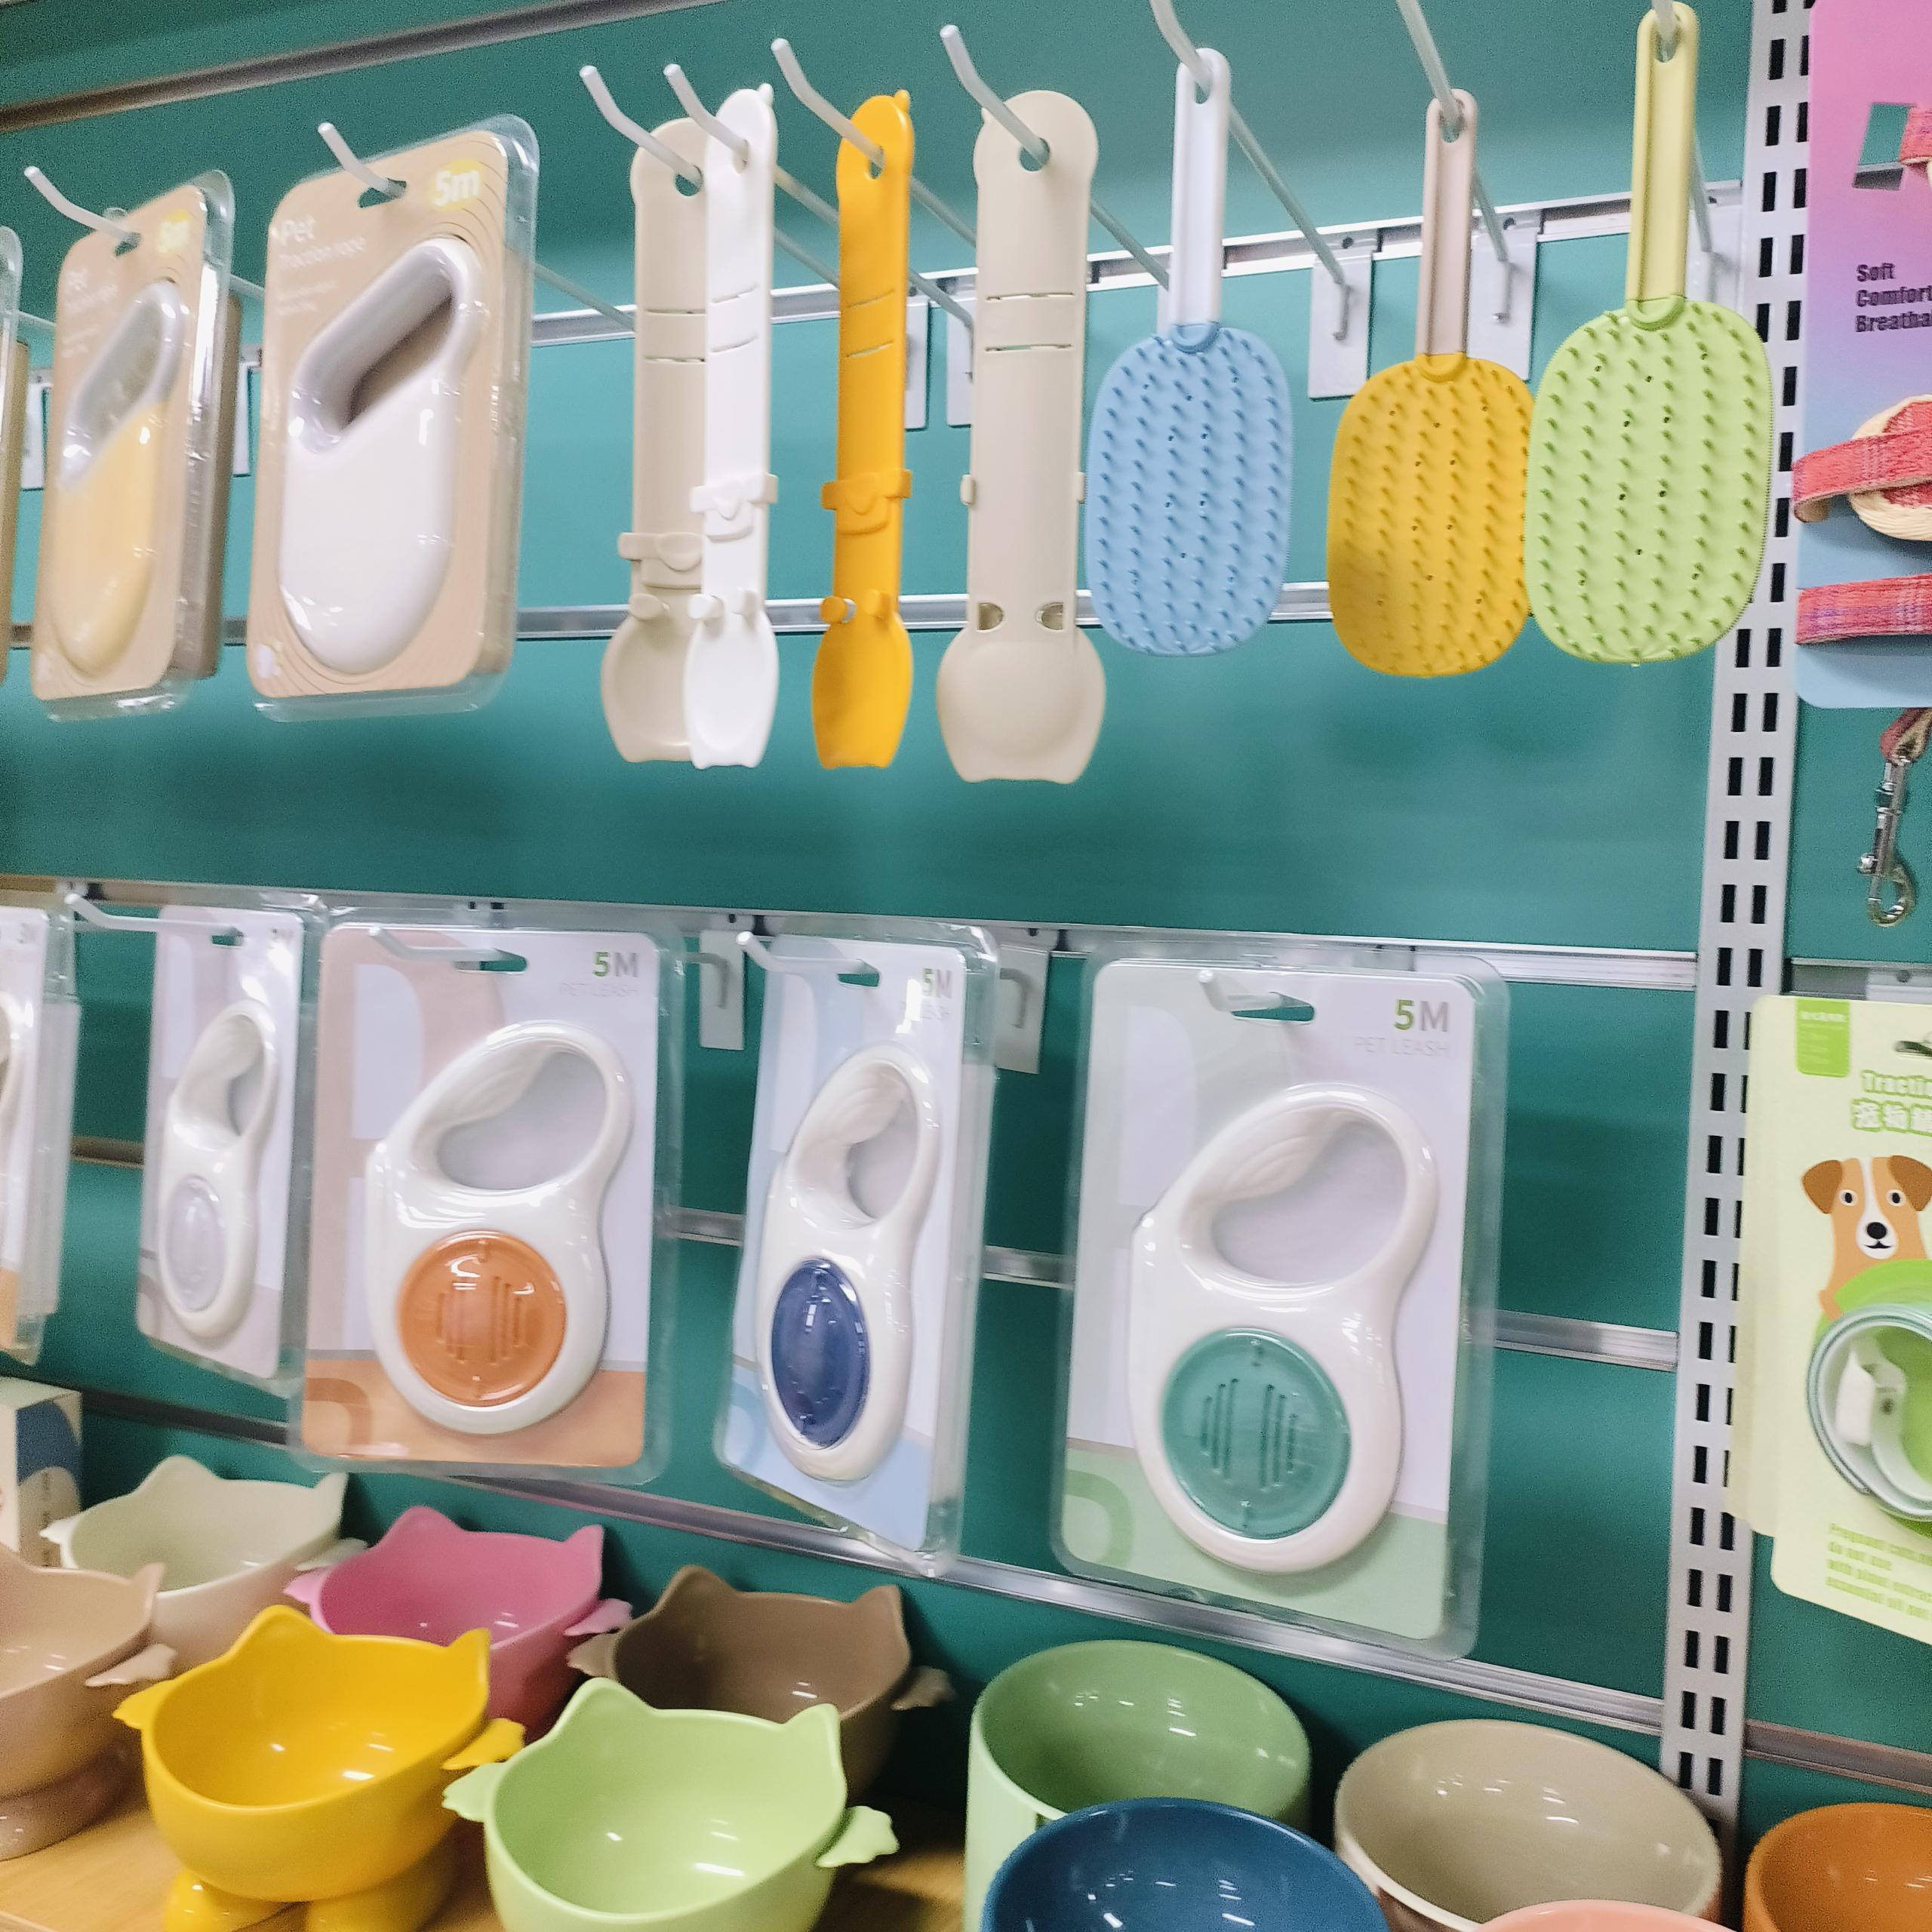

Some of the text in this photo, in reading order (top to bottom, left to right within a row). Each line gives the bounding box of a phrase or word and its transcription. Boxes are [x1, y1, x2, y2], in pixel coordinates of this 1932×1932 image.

[433, 168, 482, 208] 5m
[1856, 262, 1895, 282] Soft
[591, 951, 639, 978] 5M
[921, 968, 953, 999] 5M
[1394, 998, 1450, 1032] 5M
[1354, 1035, 1449, 1057] PET LEASH
